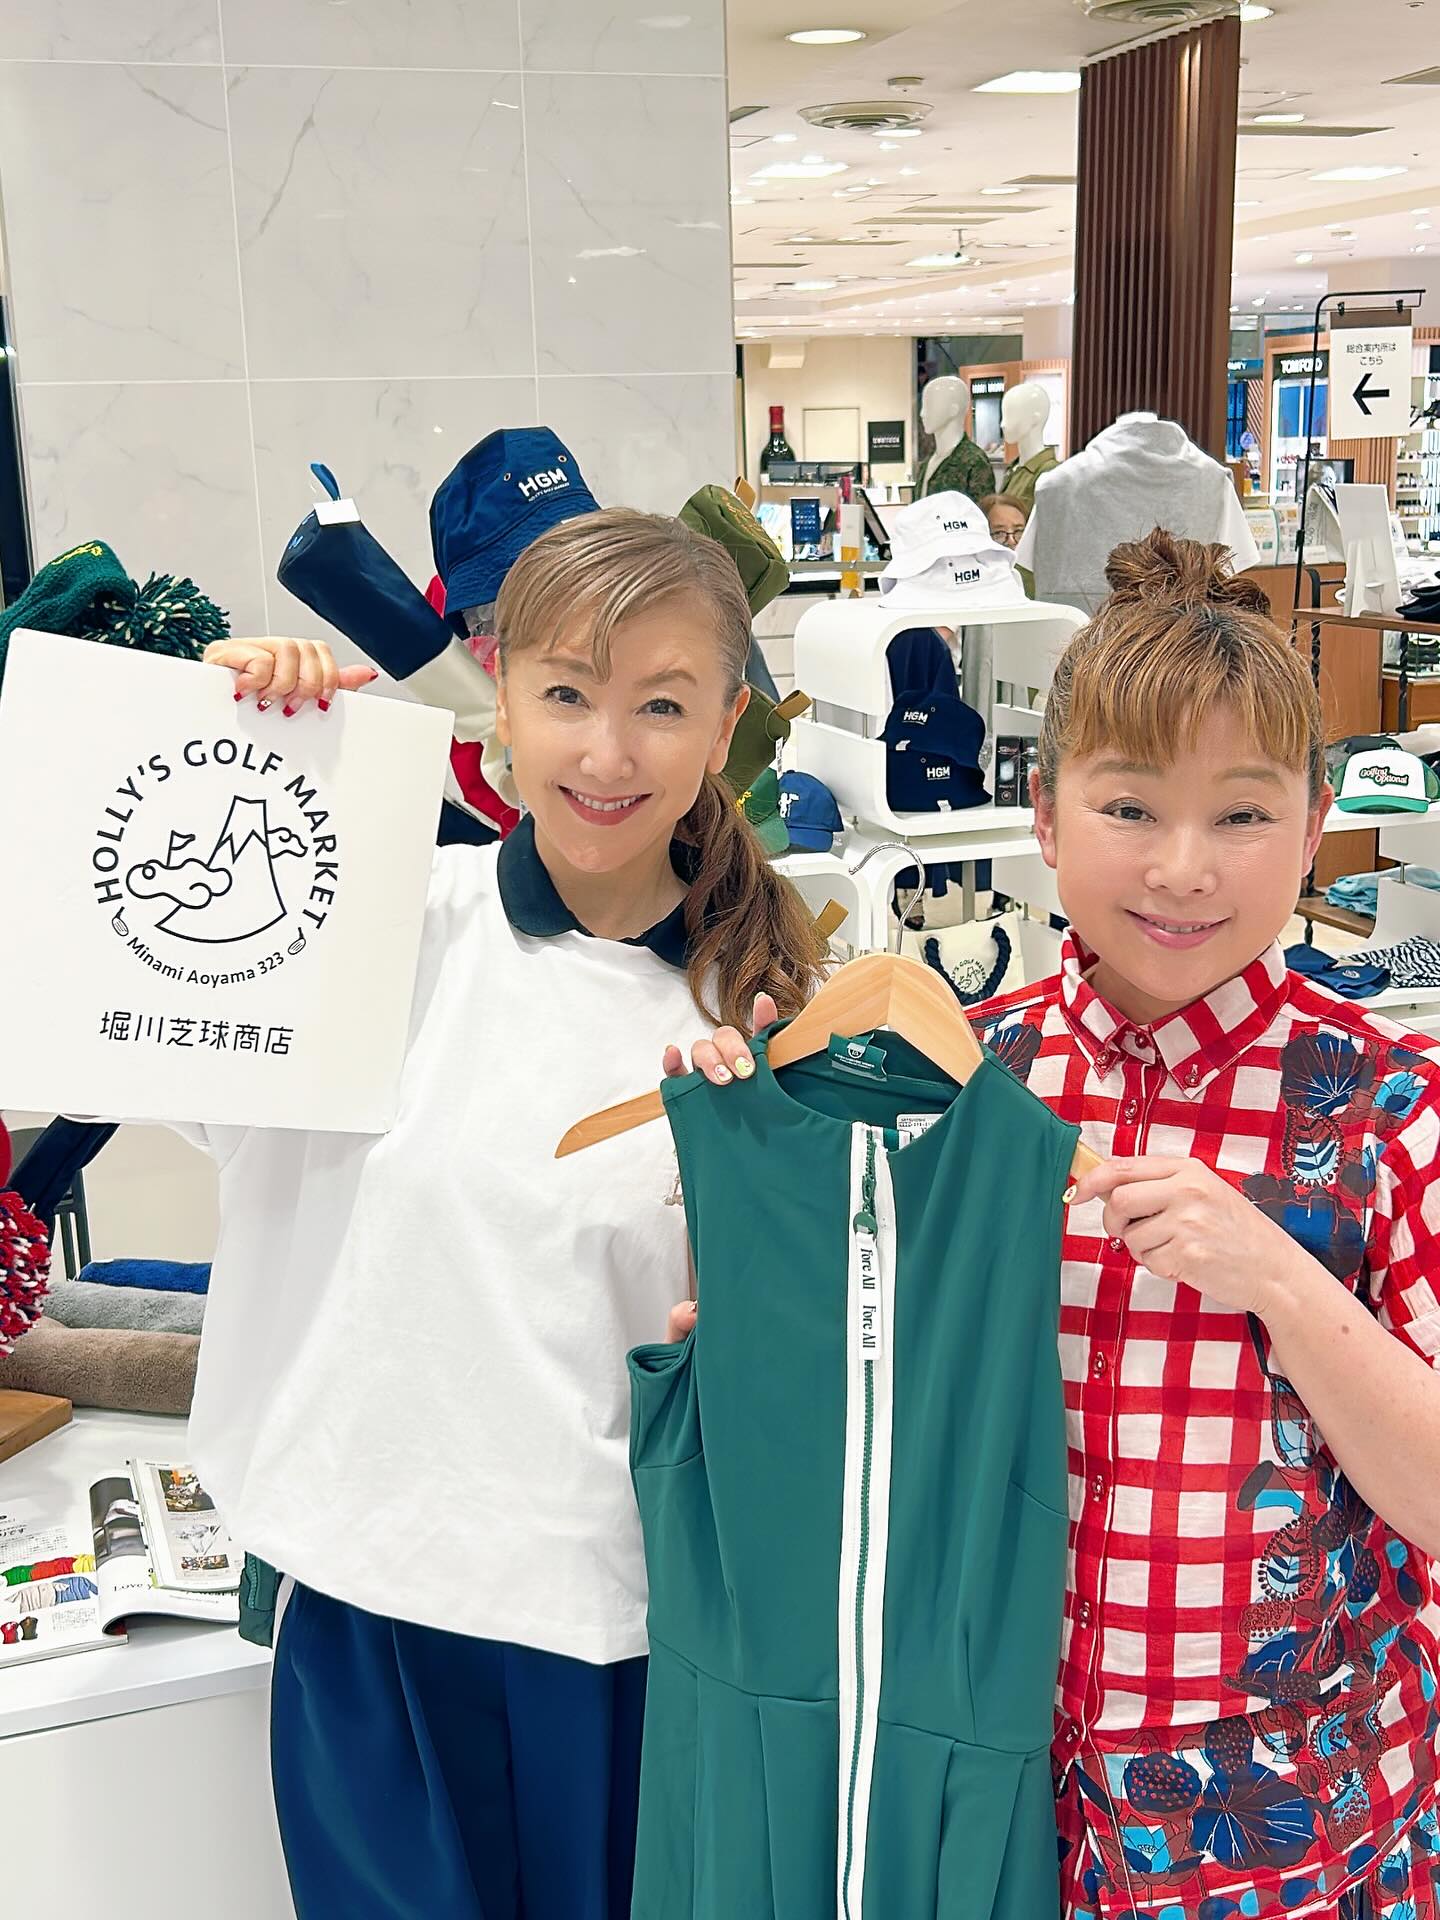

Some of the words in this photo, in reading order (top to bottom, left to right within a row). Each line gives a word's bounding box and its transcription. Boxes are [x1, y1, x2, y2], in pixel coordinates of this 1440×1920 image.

[1360, 355, 1383, 366] こちら
[518, 468, 568, 497] HGM
[943, 521, 968, 531] HGM
[954, 569, 980, 582] HGM
[903, 711, 928, 723] HGM
[926, 766, 950, 778] HGM
[93, 755, 171, 904] HOLLY'S
[184, 739, 283, 776] GOLF
[284, 775, 338, 930] MARKET
[127, 937, 185, 981] Minami
[187, 968, 256, 988] Aoyama
[257, 951, 285, 975] 323
[100, 1011, 294, 1055] 堀川芝球商店
[860, 1248, 873, 1271] Fore
[862, 1274, 876, 1290] All
[863, 1305, 876, 1330] Fore
[862, 1333, 876, 1348] All
